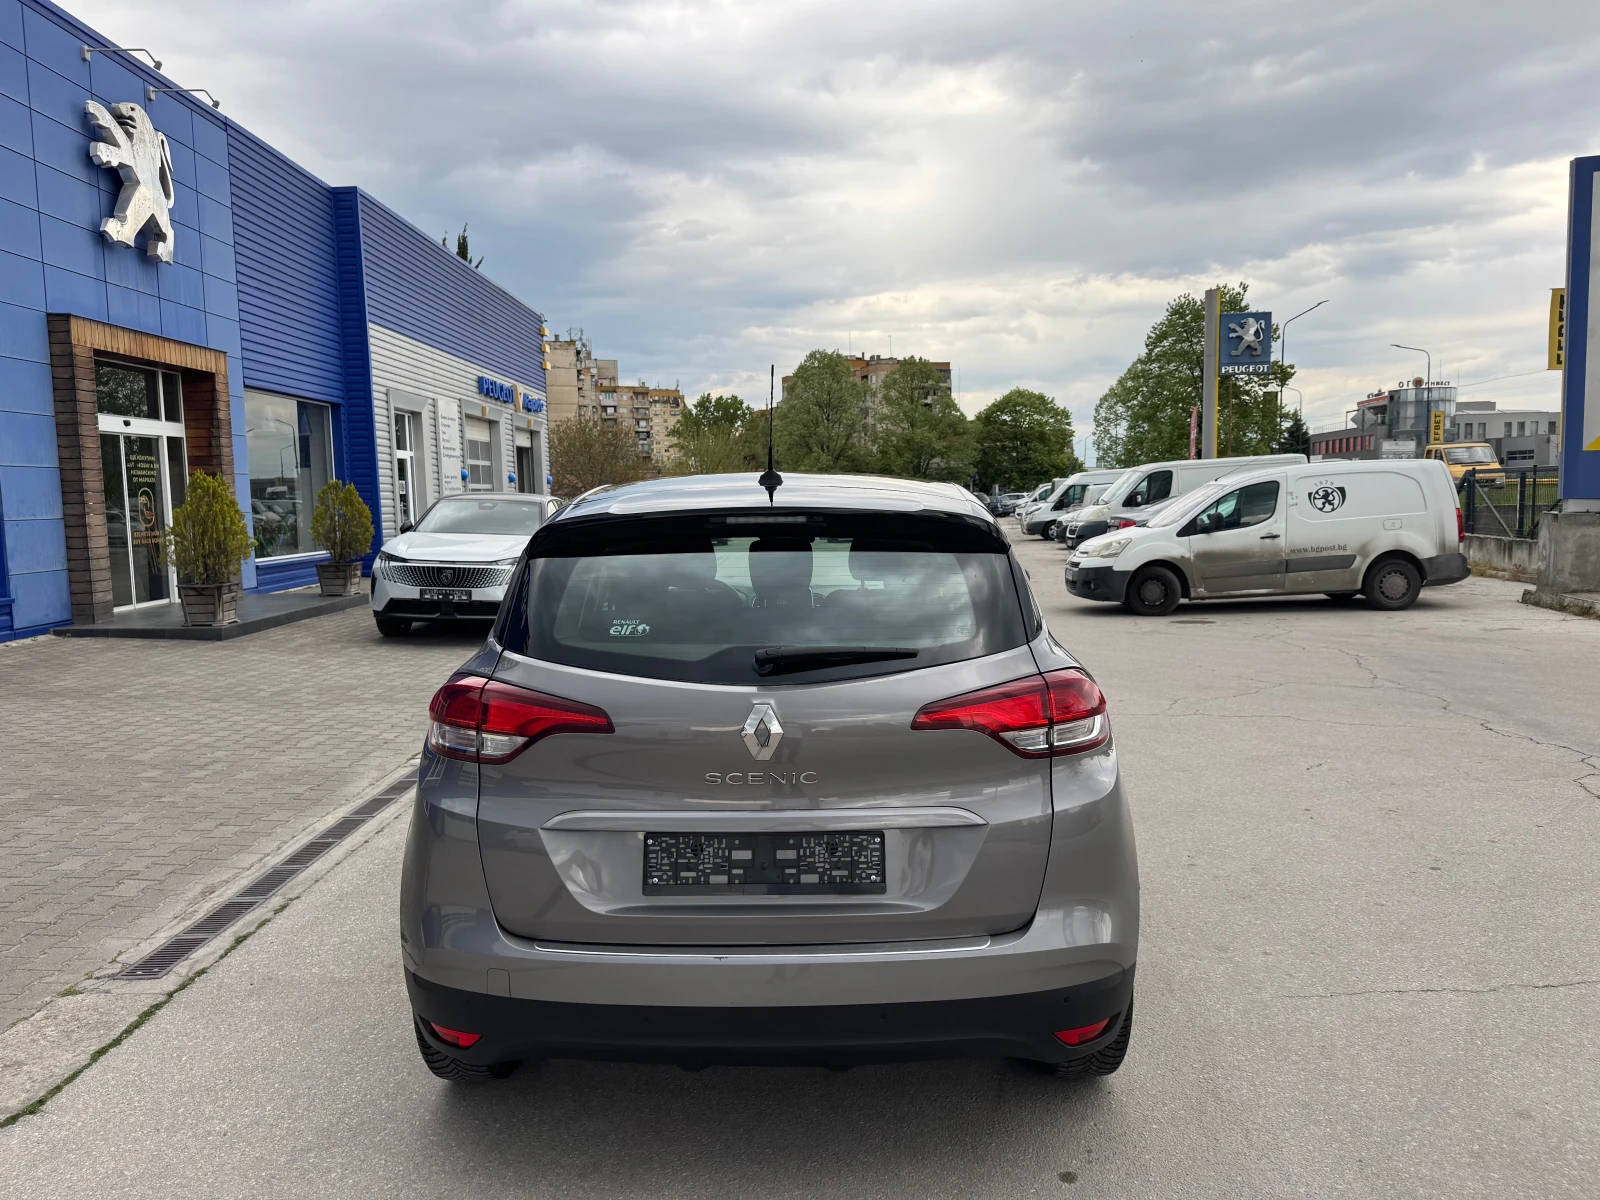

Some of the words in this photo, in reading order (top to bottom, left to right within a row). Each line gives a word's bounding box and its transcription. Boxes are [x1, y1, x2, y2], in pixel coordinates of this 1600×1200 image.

[1221, 364, 1270, 374] PEUGEOT
[1433, 412, 1442, 442] EFBET
[1313, 479, 1335, 488] 1879
[1290, 543, 1348, 554] www.bgpost.bg
[609, 624, 637, 635] elf
[704, 771, 818, 785] SCENIC
